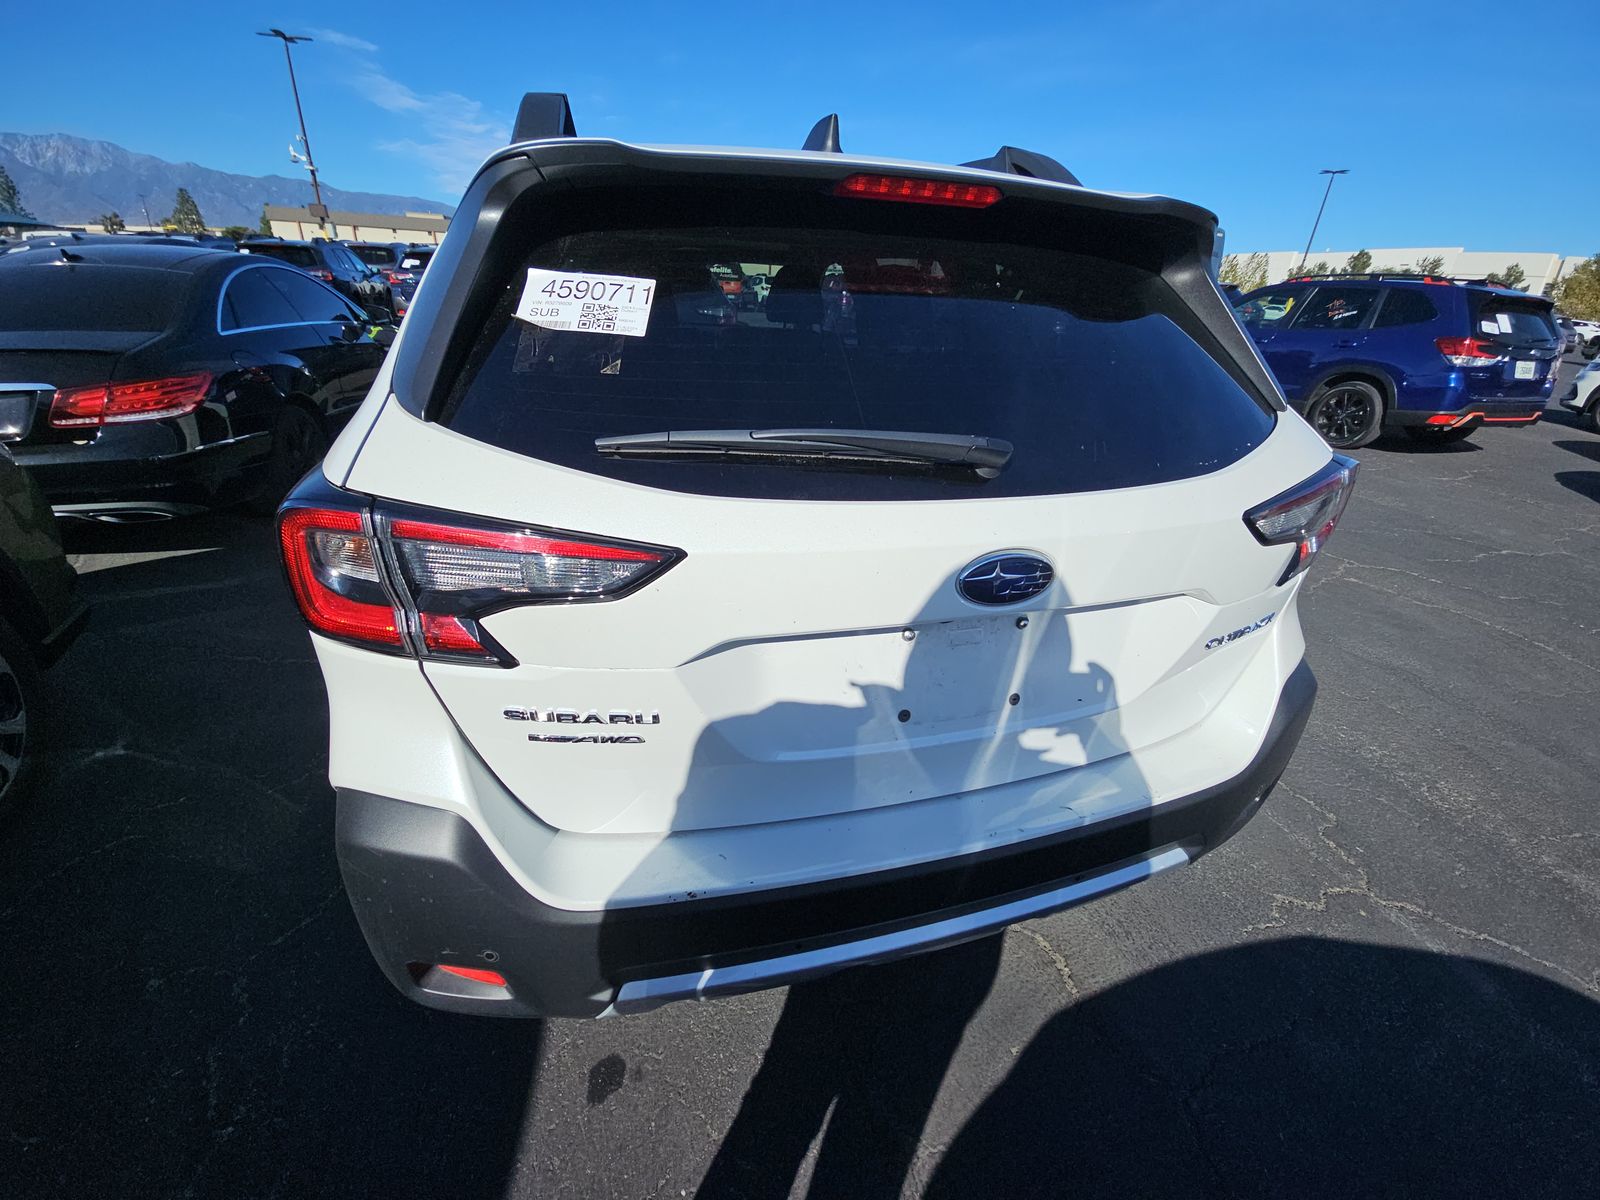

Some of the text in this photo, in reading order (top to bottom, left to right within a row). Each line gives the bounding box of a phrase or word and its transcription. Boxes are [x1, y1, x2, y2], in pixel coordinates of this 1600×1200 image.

[541, 279, 652, 305] 4590711
[529, 307, 560, 317] SUB
[502, 705, 661, 725] SUBARU
